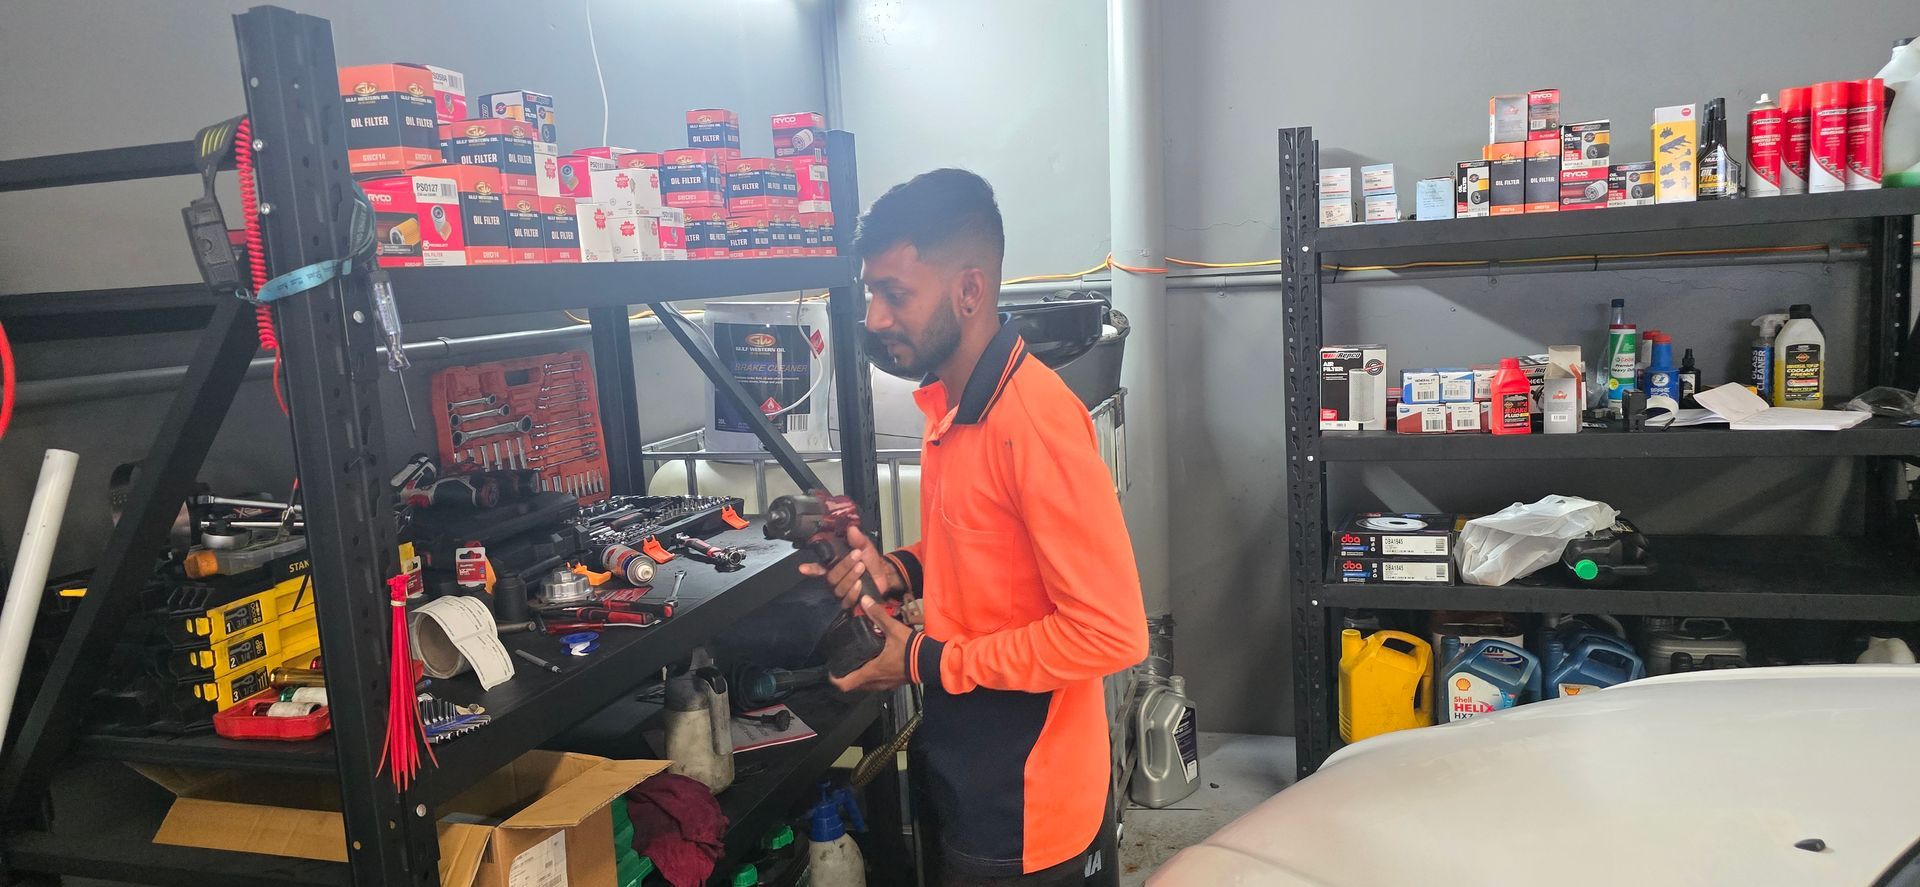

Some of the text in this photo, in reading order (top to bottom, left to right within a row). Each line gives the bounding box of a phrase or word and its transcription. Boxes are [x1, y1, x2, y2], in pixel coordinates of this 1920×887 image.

[351, 116, 389, 128] OIL FILTER
[406, 116, 434, 129] OIL FILTER
[774, 116, 796, 124] RYCO
[461, 153, 498, 165] OIL FILTER
[508, 153, 532, 165] OIL FILTER
[682, 176, 701, 184] FILTER
[368, 193, 392, 202] RYCO
[473, 216, 500, 225] OIL FILTER
[514, 228, 539, 238] OIL FILTER
[552, 231, 574, 240] OIL FILTER
[736, 364, 808, 372] BRAKE CLEANER
[1757, 350, 1766, 391] CLEANER
[1341, 534, 1360, 543] dba
[288, 560, 310, 573] STAN
[1343, 560, 1362, 569] dba
[226, 624, 232, 632] 1
[230, 658, 237, 668] 2
[234, 691, 240, 701] 3
[1454, 704, 1494, 713] HELIX
